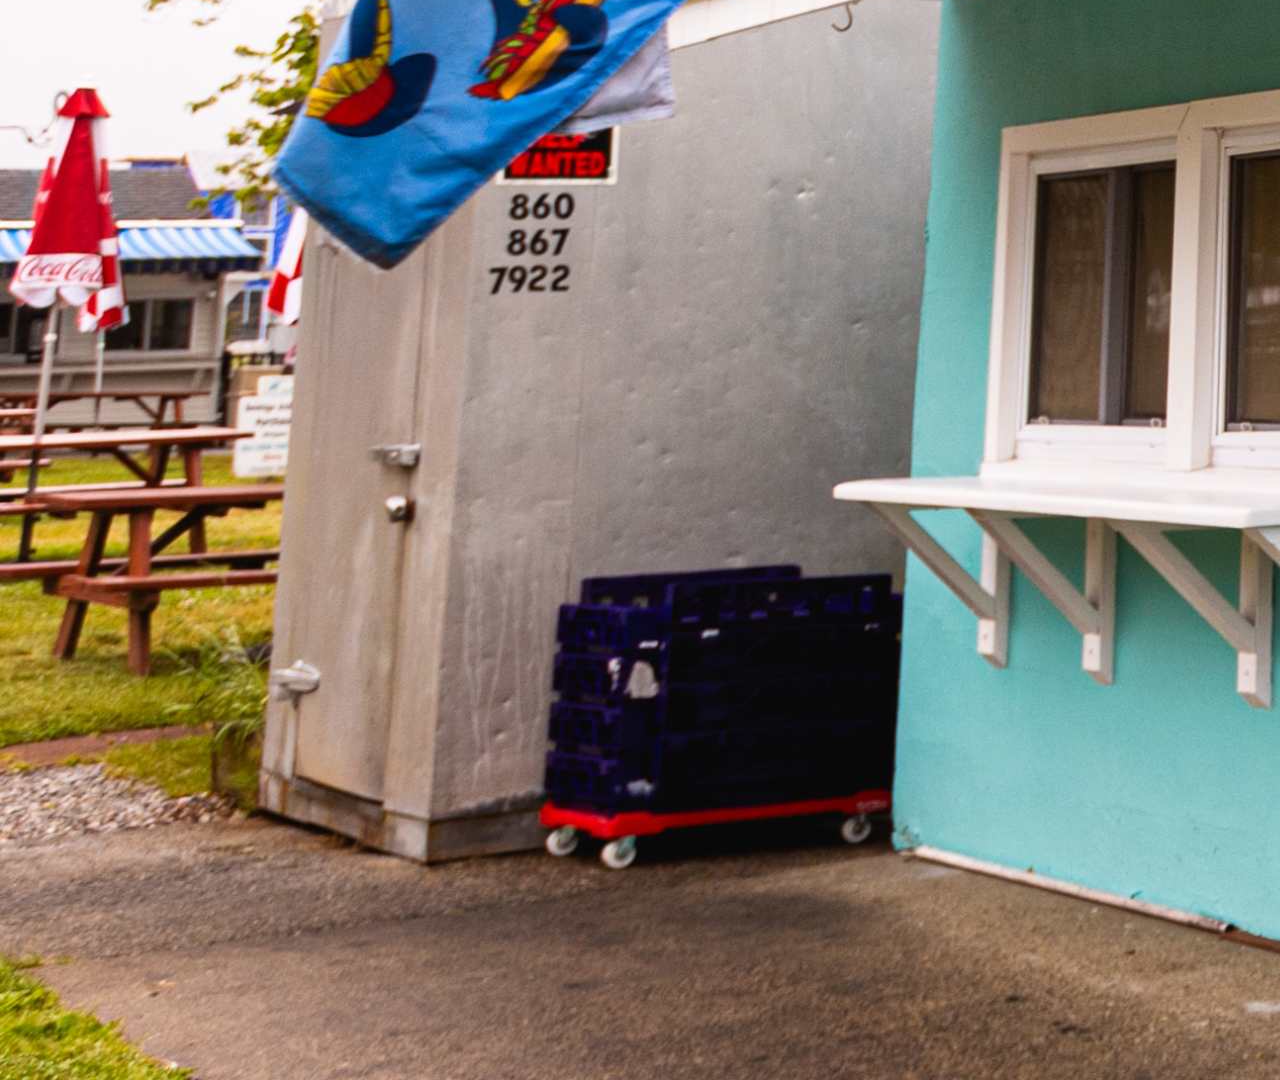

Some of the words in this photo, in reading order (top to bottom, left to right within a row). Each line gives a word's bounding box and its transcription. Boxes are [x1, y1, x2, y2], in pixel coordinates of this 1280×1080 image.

[511, 151, 606, 177] WANTED
[509, 192, 575, 220] 860
[506, 228, 571, 256] 867
[489, 264, 571, 295] 7922
